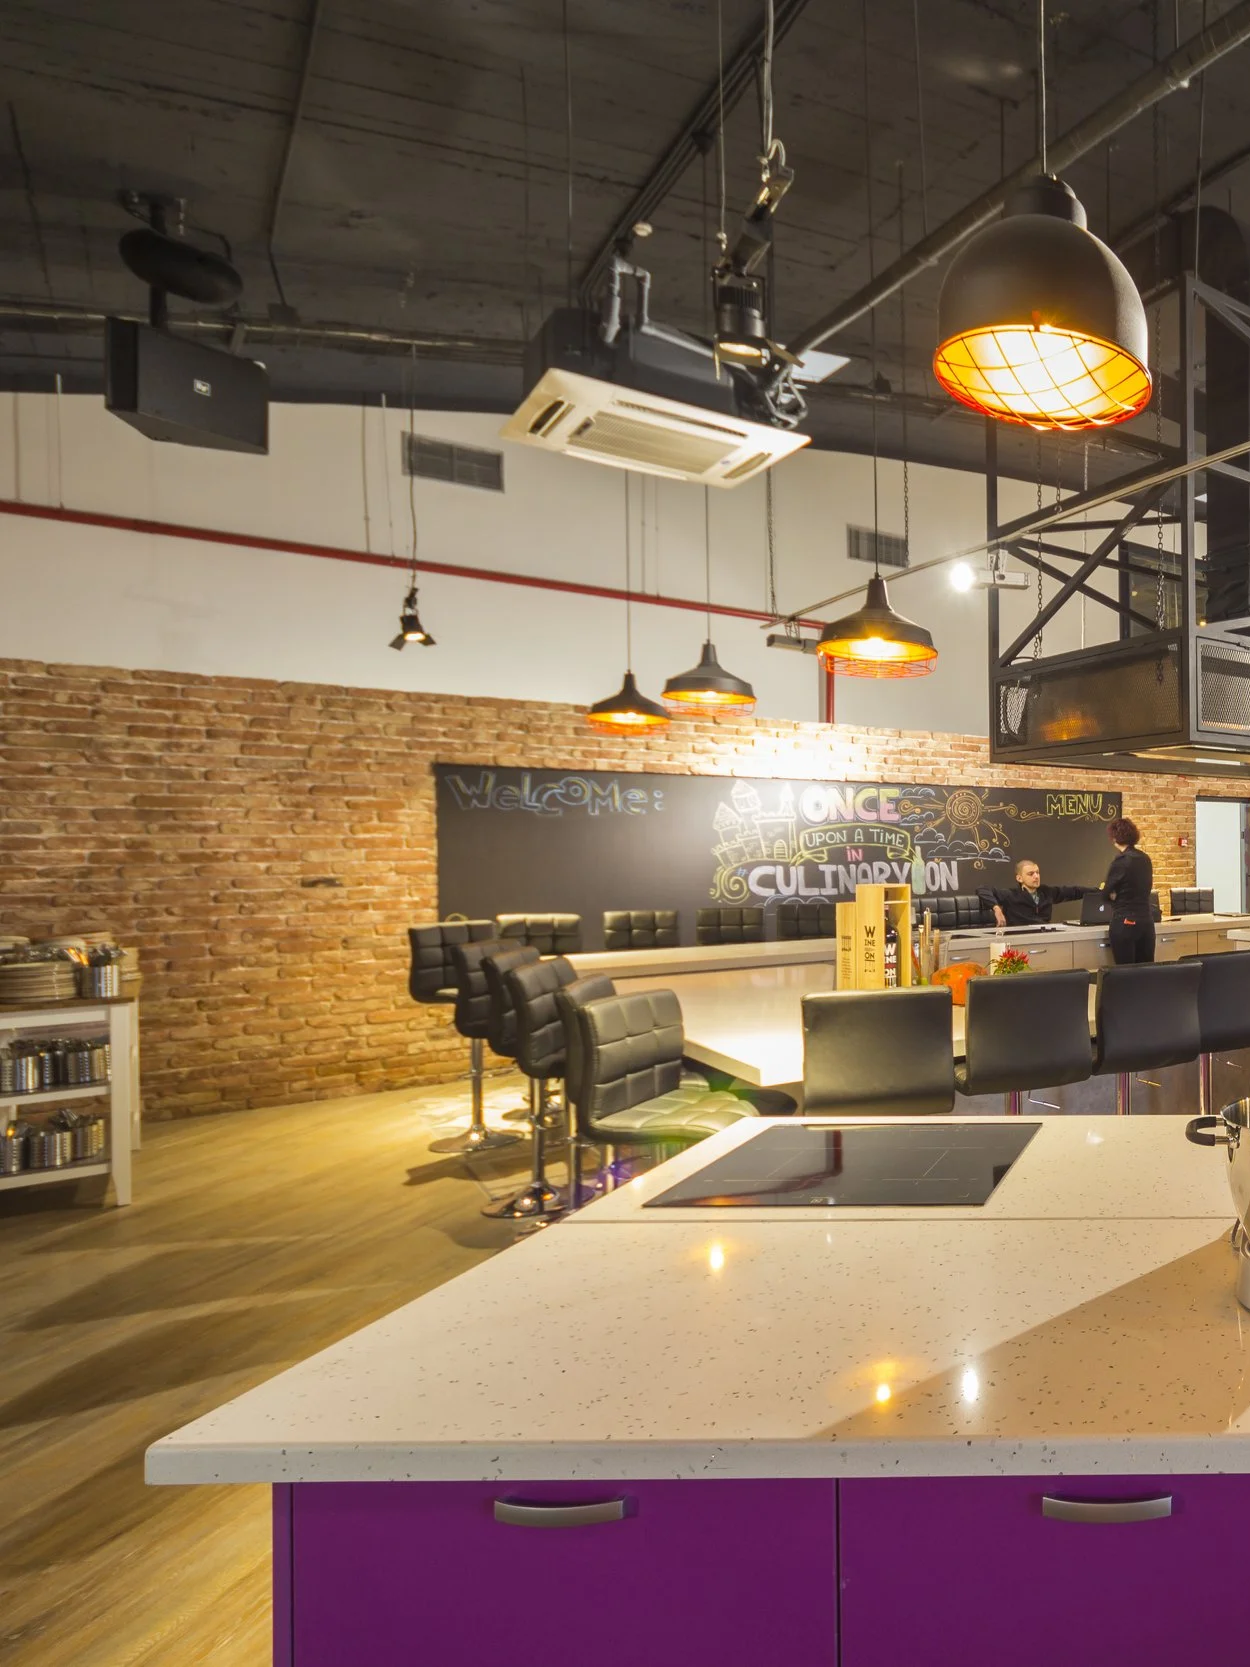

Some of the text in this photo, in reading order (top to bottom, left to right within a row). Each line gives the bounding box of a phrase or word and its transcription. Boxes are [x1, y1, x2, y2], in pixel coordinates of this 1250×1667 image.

[801, 785, 900, 825] ONCE
[1046, 793, 1103, 815] MENU
[805, 830, 847, 847] UPON
[854, 828, 864, 842] A
[864, 952, 875, 960] ON
